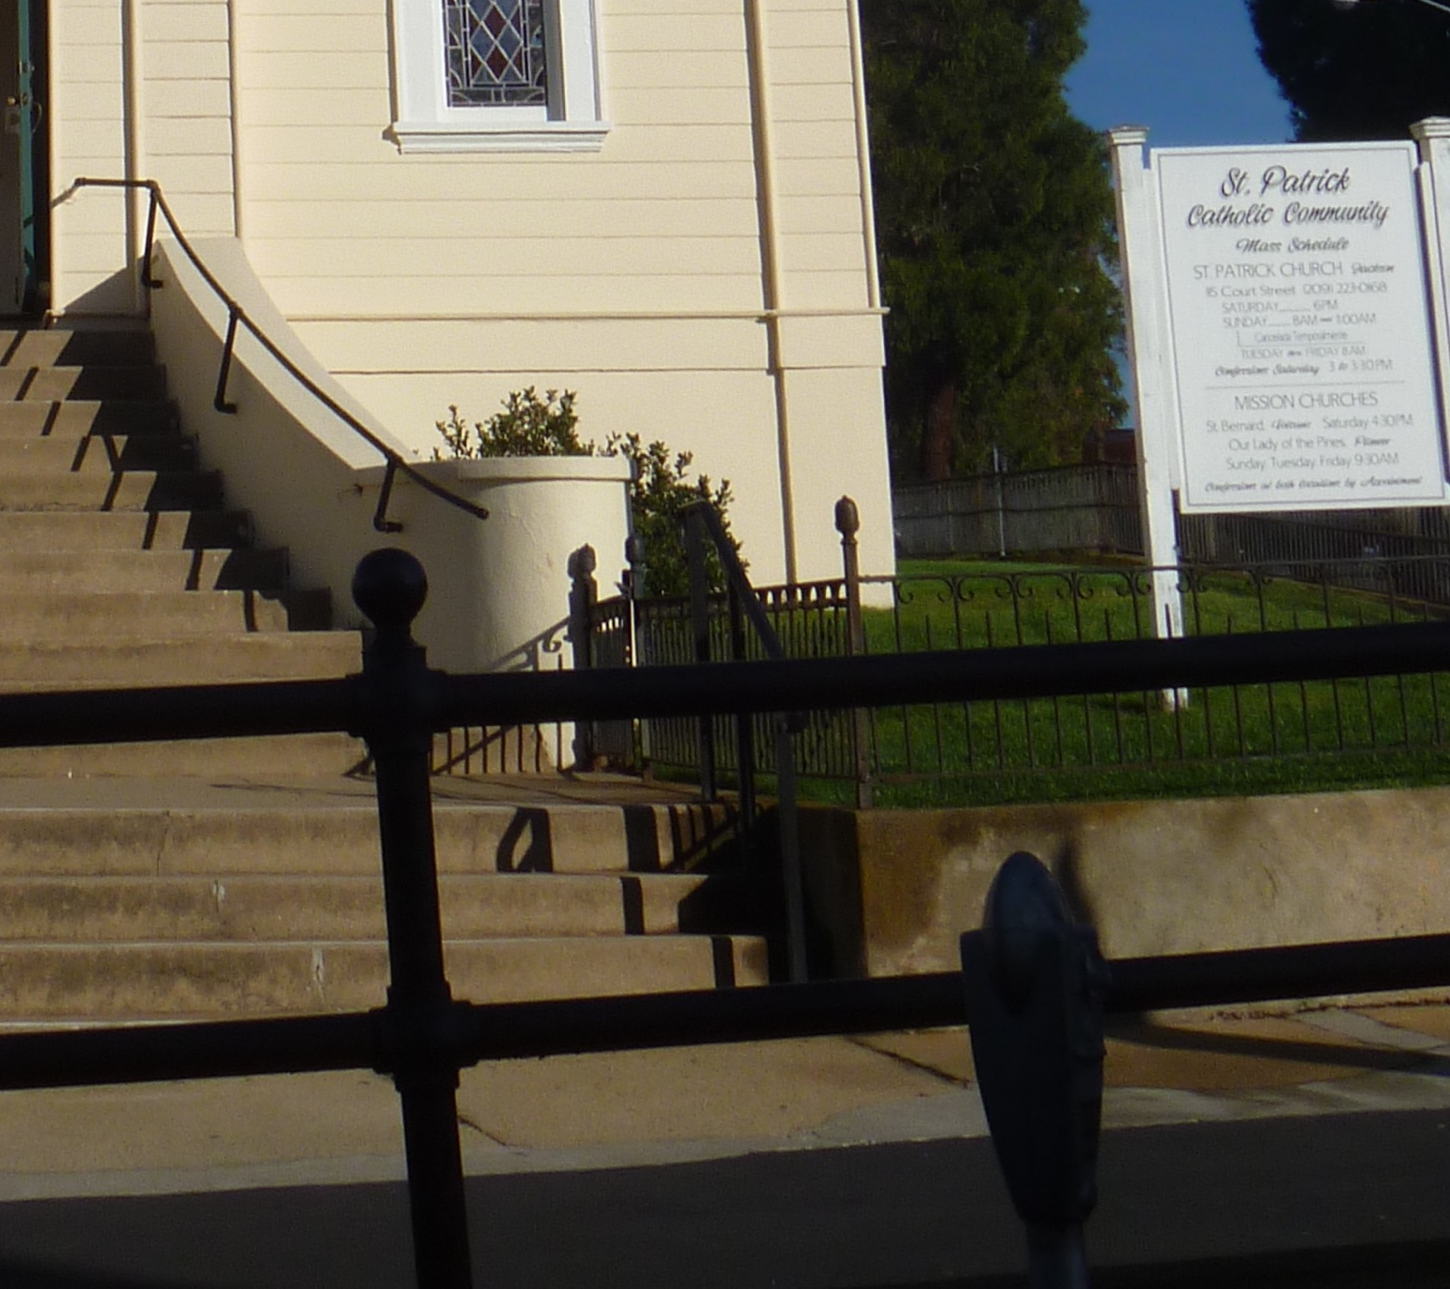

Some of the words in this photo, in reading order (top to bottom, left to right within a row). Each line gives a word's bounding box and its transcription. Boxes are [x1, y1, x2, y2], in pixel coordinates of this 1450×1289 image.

[1221, 167, 1250, 198] St.
[1261, 165, 1350, 197] Patrick
[1188, 203, 1274, 228] Catholic
[1284, 199, 1390, 229] Community
[1235, 238, 1282, 254] Mass
[1287, 236, 1349, 253] Schedule
[1215, 262, 1275, 278] PATRICK
[1279, 261, 1343, 278] CHURCH
[1220, 284, 1256, 297] Court
[1259, 283, 1296, 296] Street
[1222, 301, 1278, 314] SATURDAY
[1223, 316, 1267, 327] SUNDAY
[1292, 314, 1318, 326] 8AM
[1234, 394, 1295, 410] MISSION
[1298, 391, 1379, 409] CHURCHES
[1322, 416, 1368, 431] Saturday
[1228, 438, 1249, 451] Our
[1253, 438, 1278, 452] Lady
[1281, 437, 1293, 449] of
[1295, 436, 1314, 449] the
[1226, 457, 1266, 472] Sunday
[1270, 455, 1316, 470] Tuesday
[1319, 454, 1352, 469] Friday
